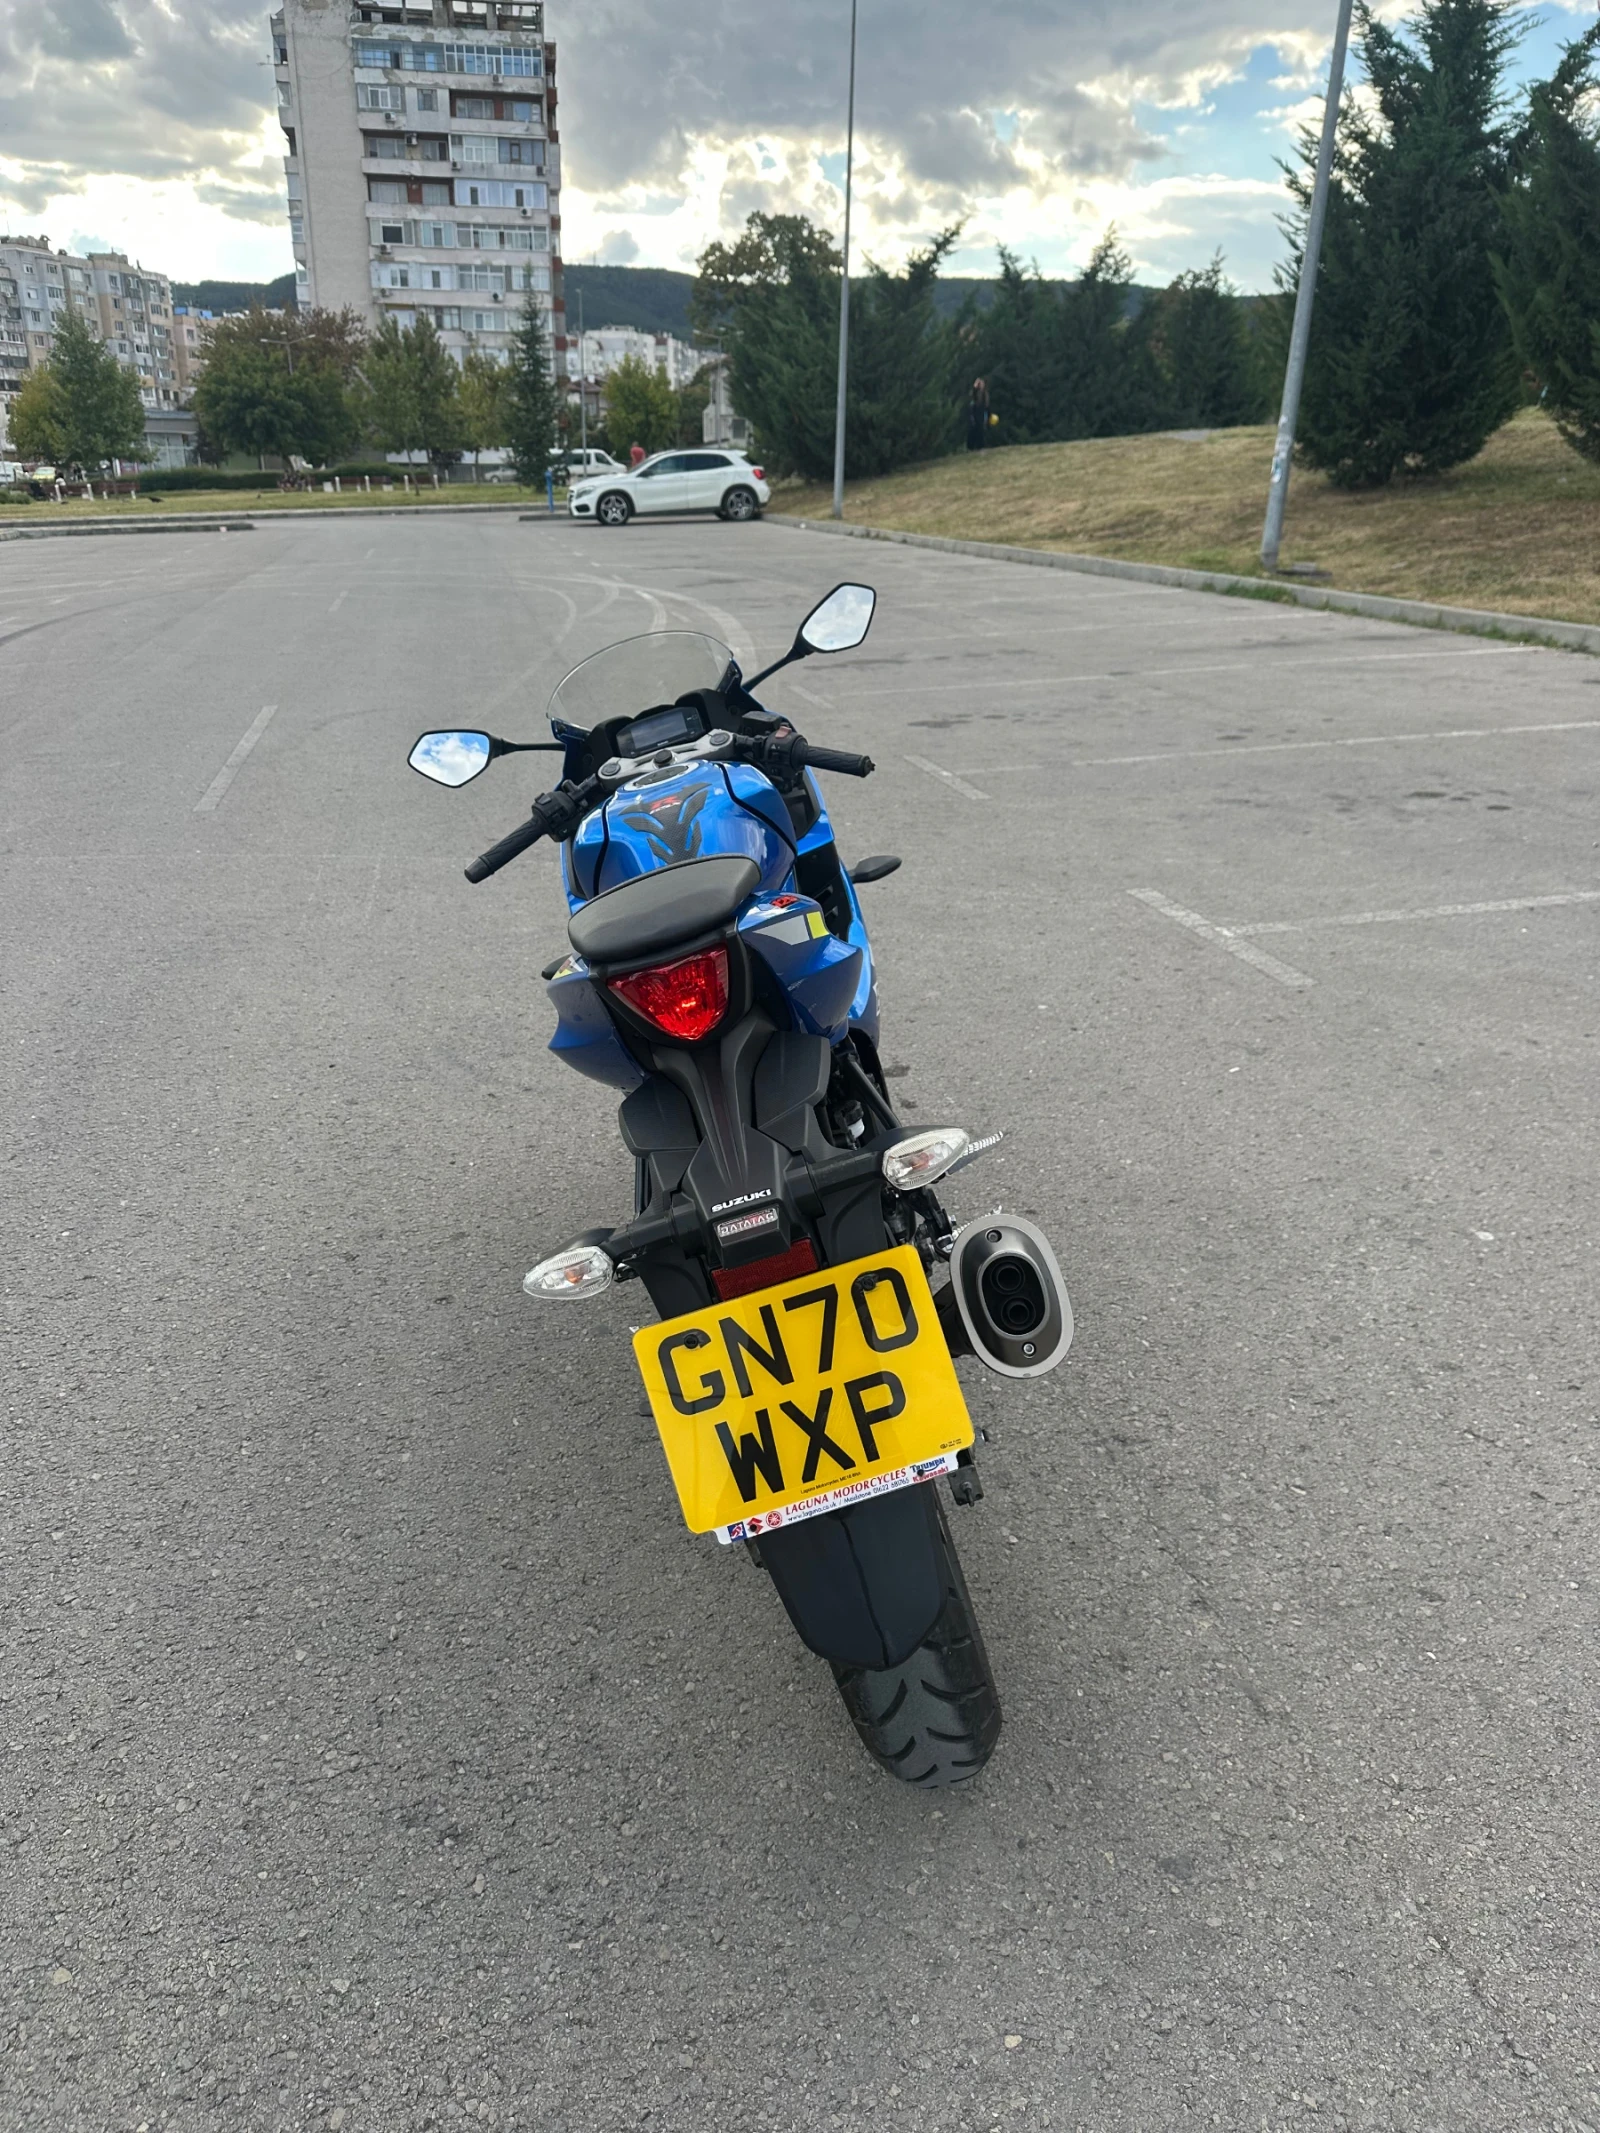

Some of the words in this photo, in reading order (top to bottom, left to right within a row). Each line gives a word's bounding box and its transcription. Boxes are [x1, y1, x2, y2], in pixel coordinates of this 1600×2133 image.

[711, 1188, 772, 1213] SUZUKI
[720, 1212, 775, 1235] DATATAG
[658, 1267, 919, 1415] GN70
[715, 1370, 907, 1504] WXP
[785, 1494, 829, 1515] LAGUNA
[833, 1467, 907, 1499] MOTORCYCLES
[787, 1501, 837, 1522] www.laguna.co.uk
[843, 1490, 872, 1505] Maidstone
